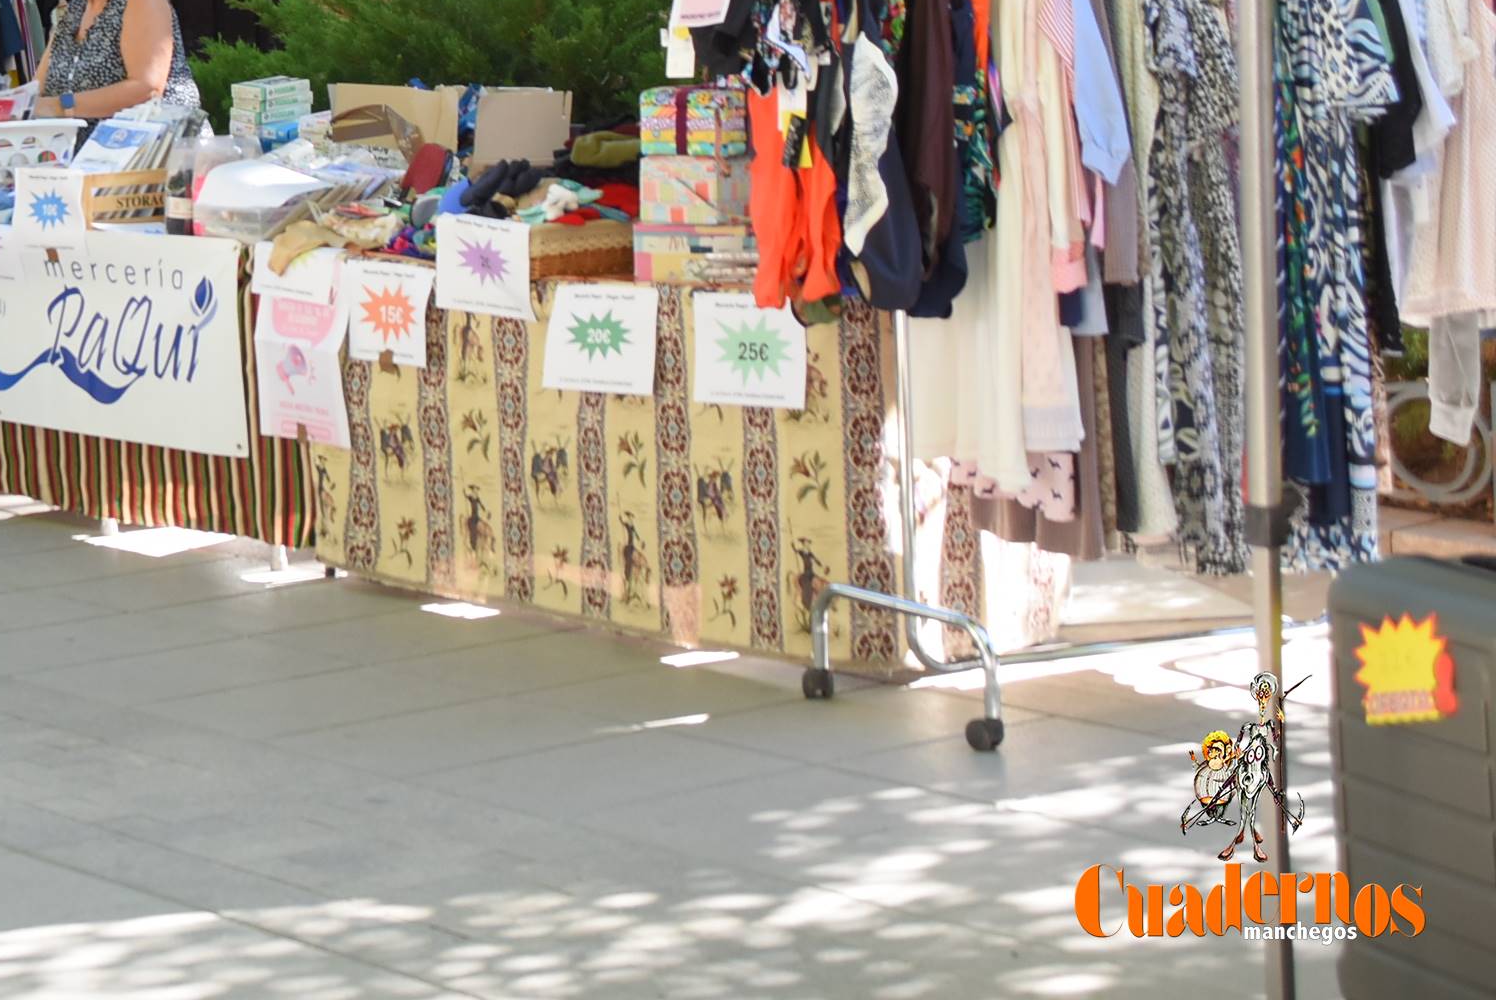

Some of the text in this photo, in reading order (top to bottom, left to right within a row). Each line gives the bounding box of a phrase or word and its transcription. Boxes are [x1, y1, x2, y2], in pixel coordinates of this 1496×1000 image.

[44, 258, 184, 291] mercería
[379, 305, 404, 325] 15€
[586, 327, 612, 345] 20€
[737, 341, 770, 362] 25€
